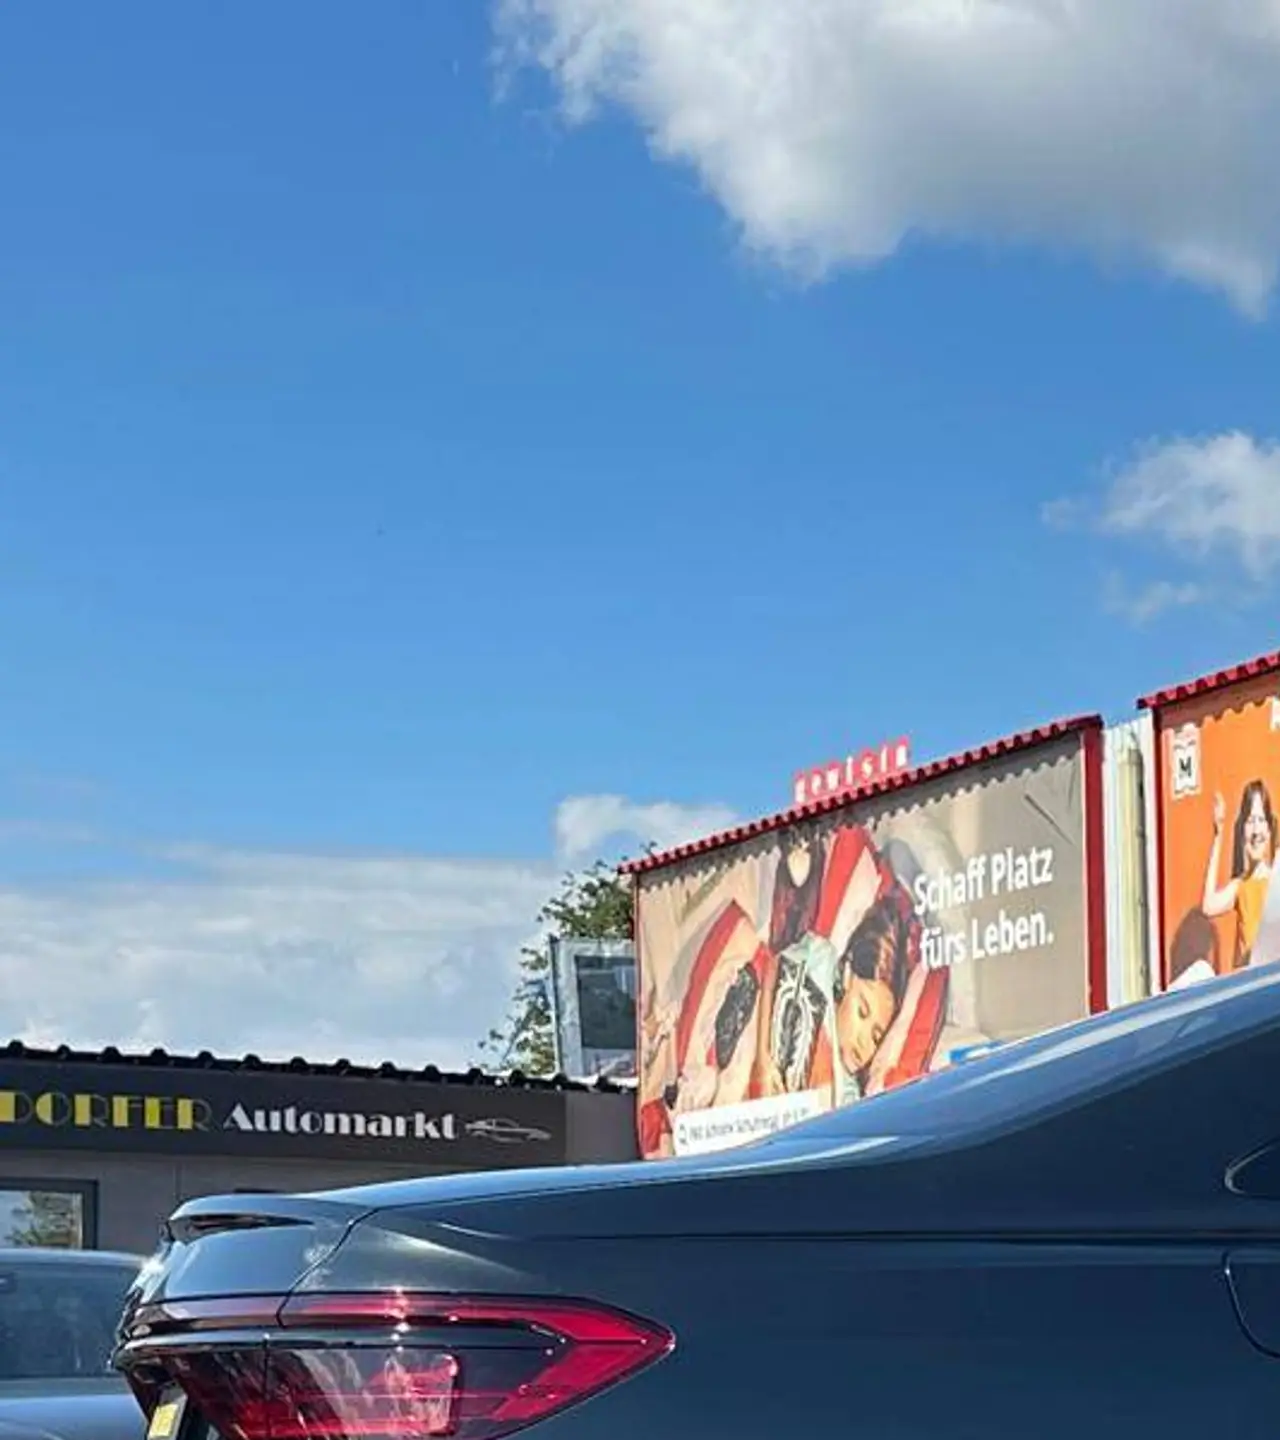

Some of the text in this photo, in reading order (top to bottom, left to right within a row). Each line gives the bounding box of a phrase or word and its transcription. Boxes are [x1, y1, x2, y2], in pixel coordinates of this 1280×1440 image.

[914, 847, 1053, 915] Schaff Platz
[920, 909, 1055, 971] fürs Leben.
[222, 1102, 459, 1140] Automarkt
